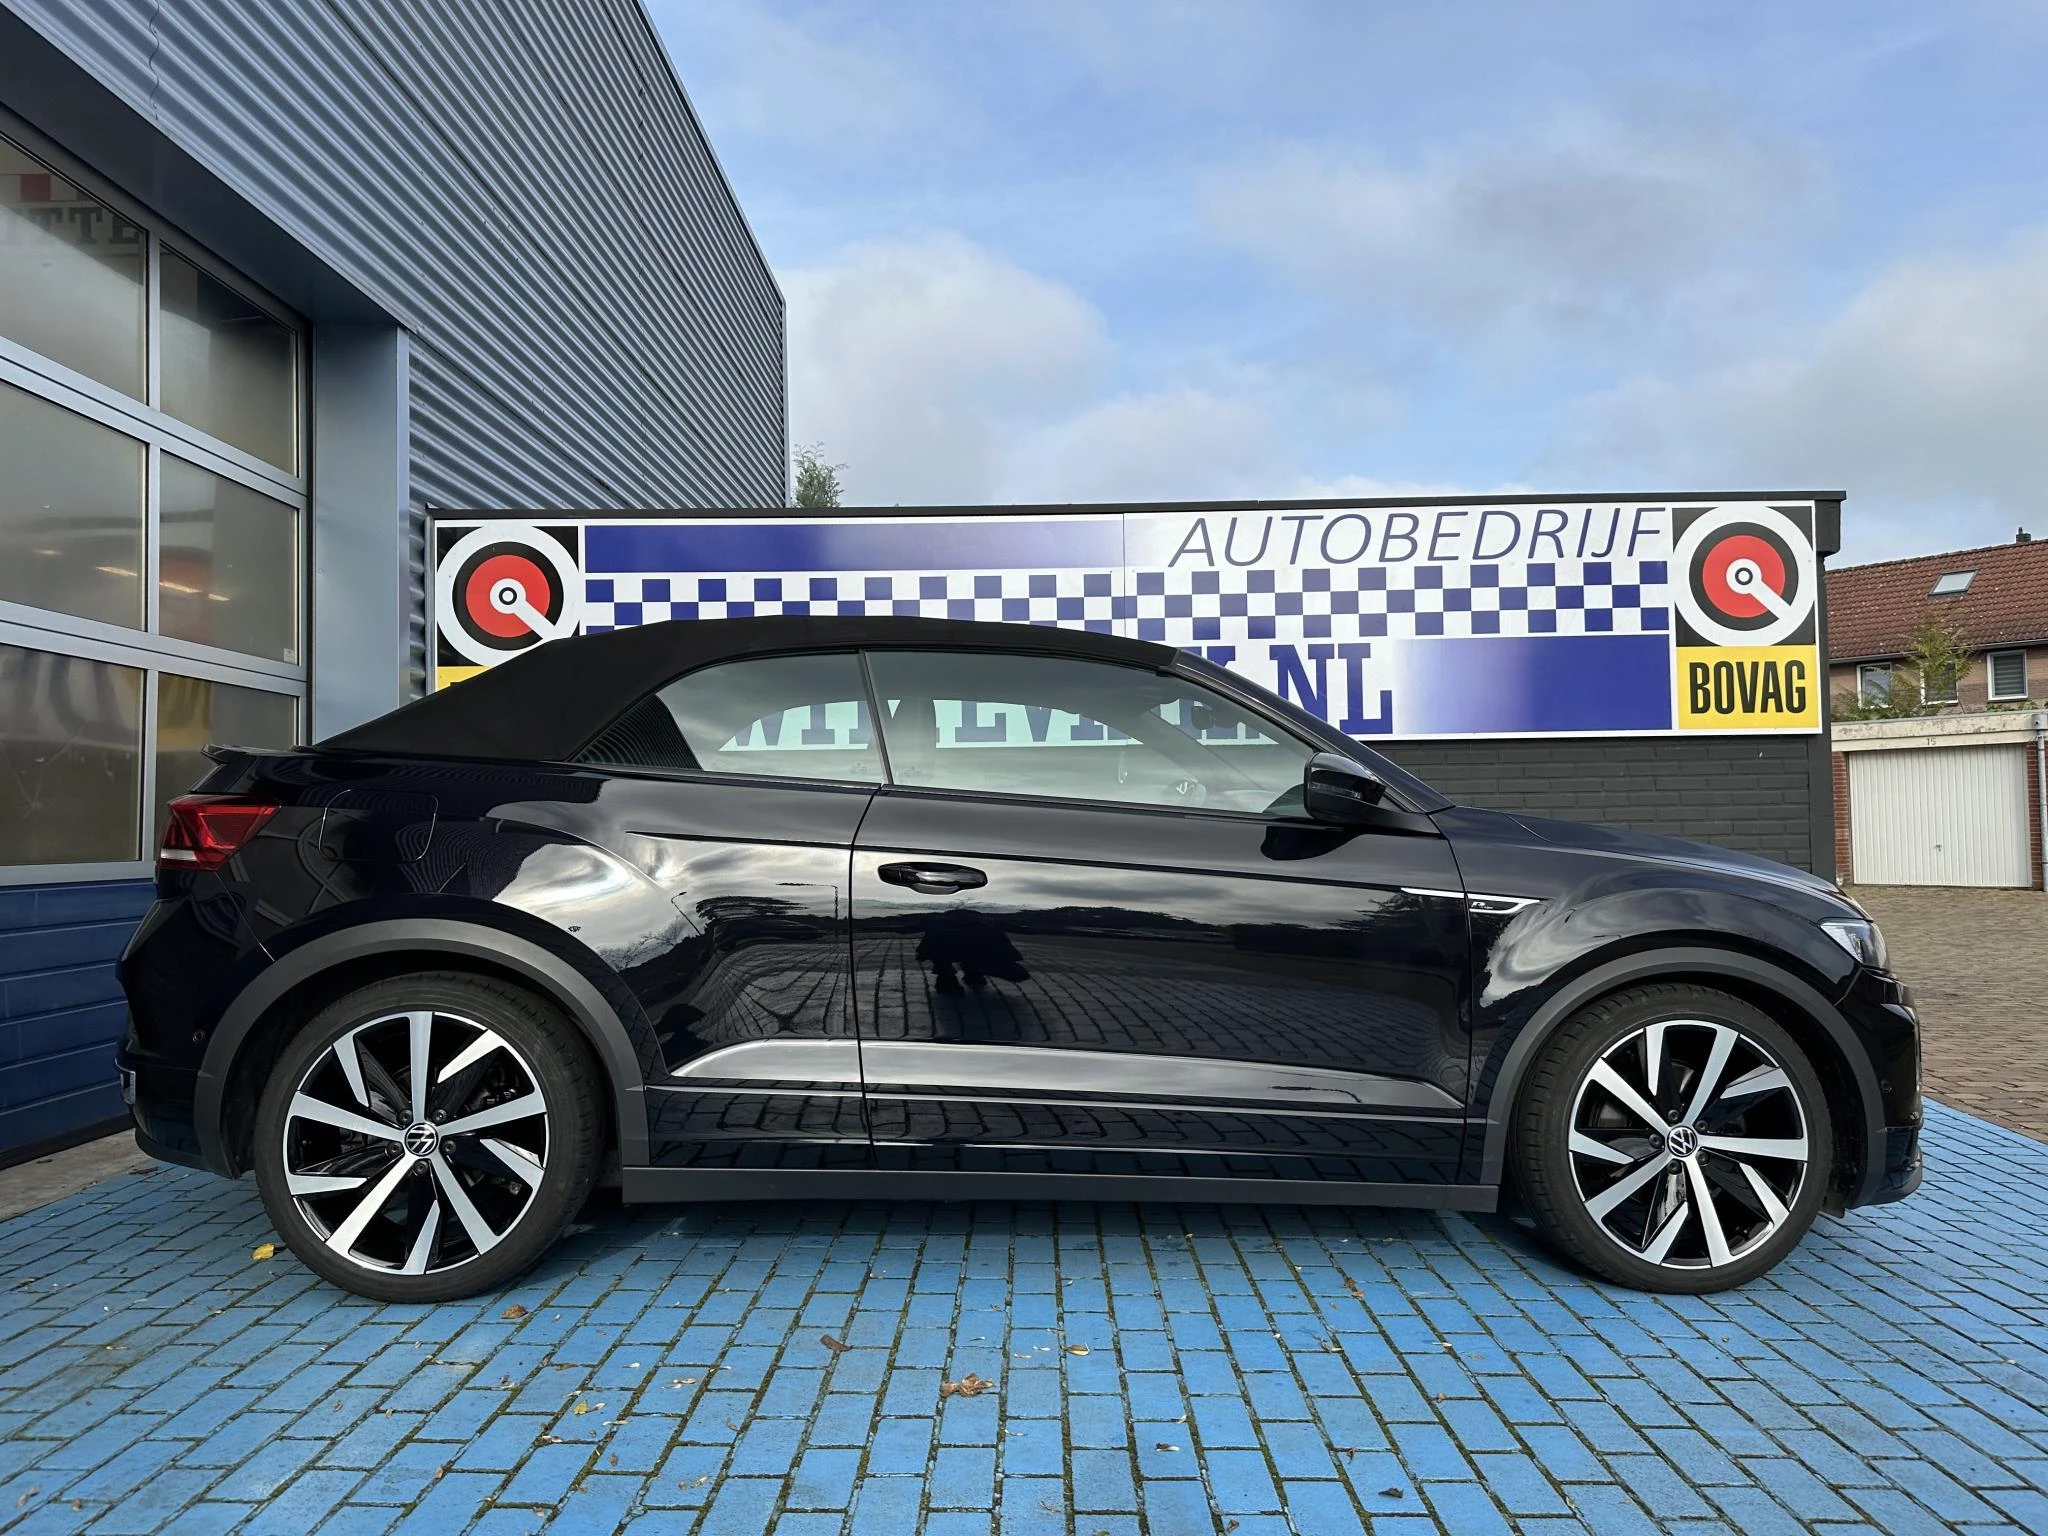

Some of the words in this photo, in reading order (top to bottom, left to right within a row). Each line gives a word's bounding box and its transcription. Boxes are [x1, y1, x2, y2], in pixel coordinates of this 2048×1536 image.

[1168, 507, 1666, 567] AUTOBEDRIJF
[1689, 659, 1806, 714] BOVAG
[1926, 737, 1937, 746] 15
